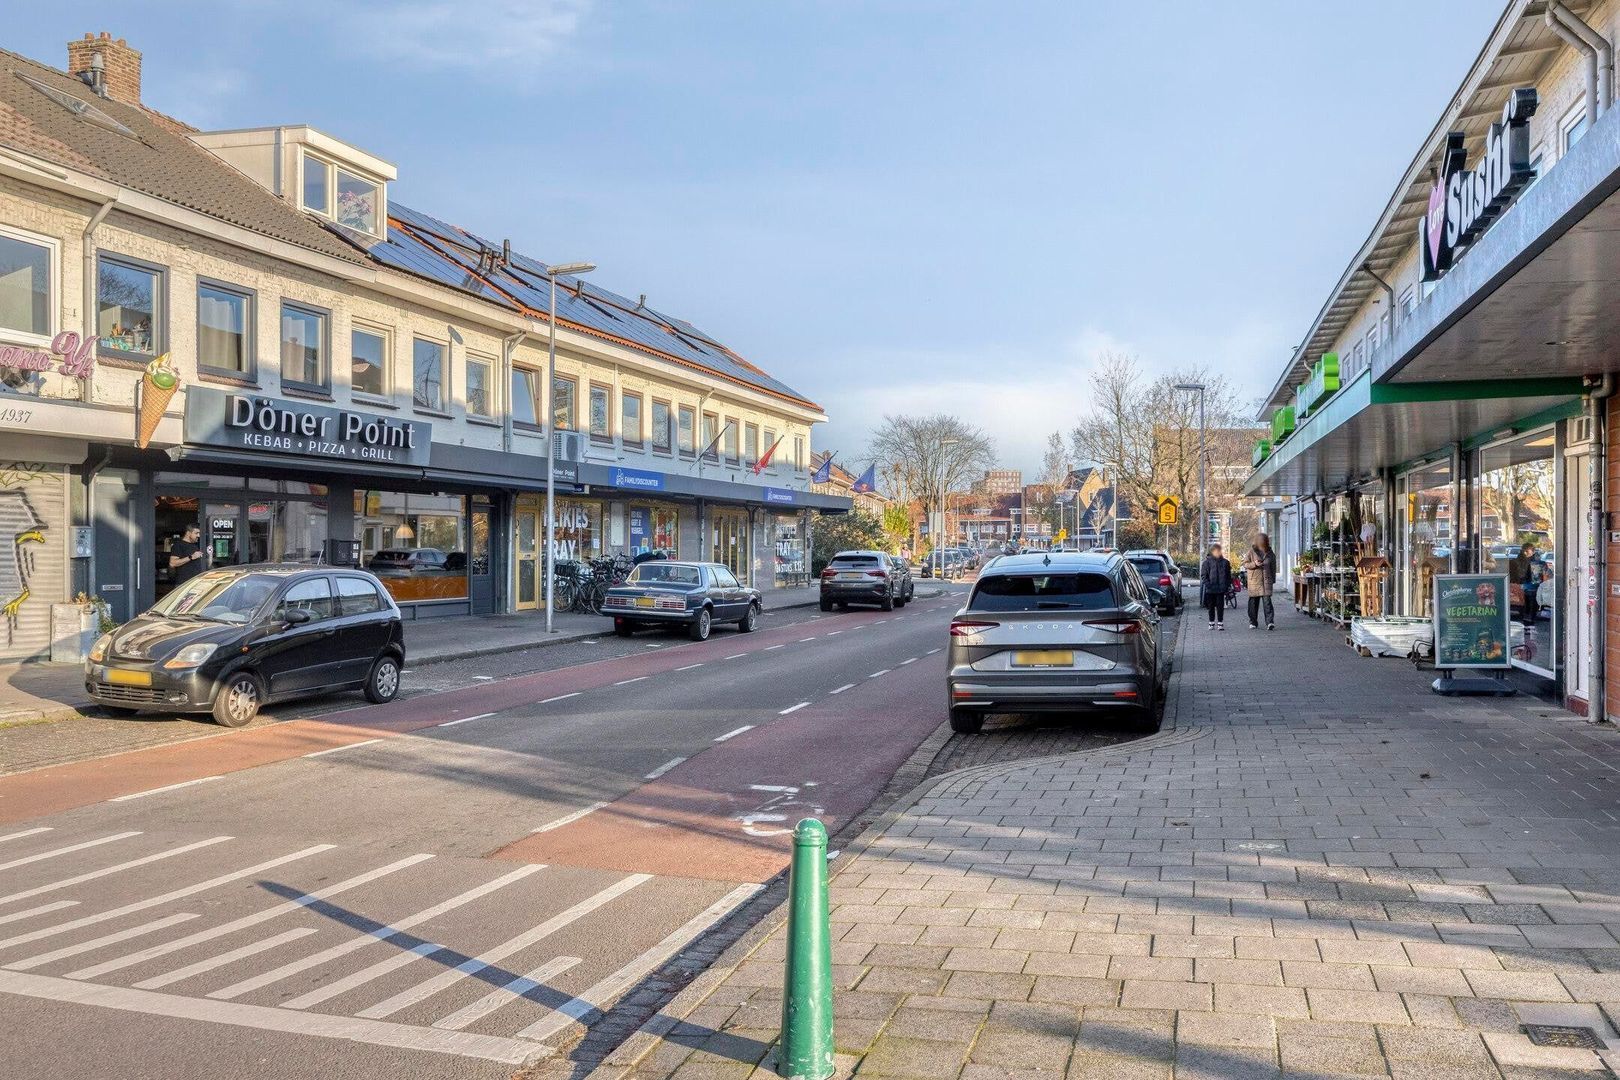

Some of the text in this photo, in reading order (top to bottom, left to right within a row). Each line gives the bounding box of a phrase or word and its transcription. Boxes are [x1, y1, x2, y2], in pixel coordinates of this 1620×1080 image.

[1446, 99, 1513, 248] Sushi
[0, 408, 33, 423] 1937
[230, 395, 416, 449] Döner Point
[244, 433, 394, 461] KEBAB PIZZA GRILL
[213, 519, 234, 529] OPEN
[1164, 511, 1172, 521] 5
[544, 539, 577, 560] RAY
[1446, 605, 1497, 616] VEGETARIAN
